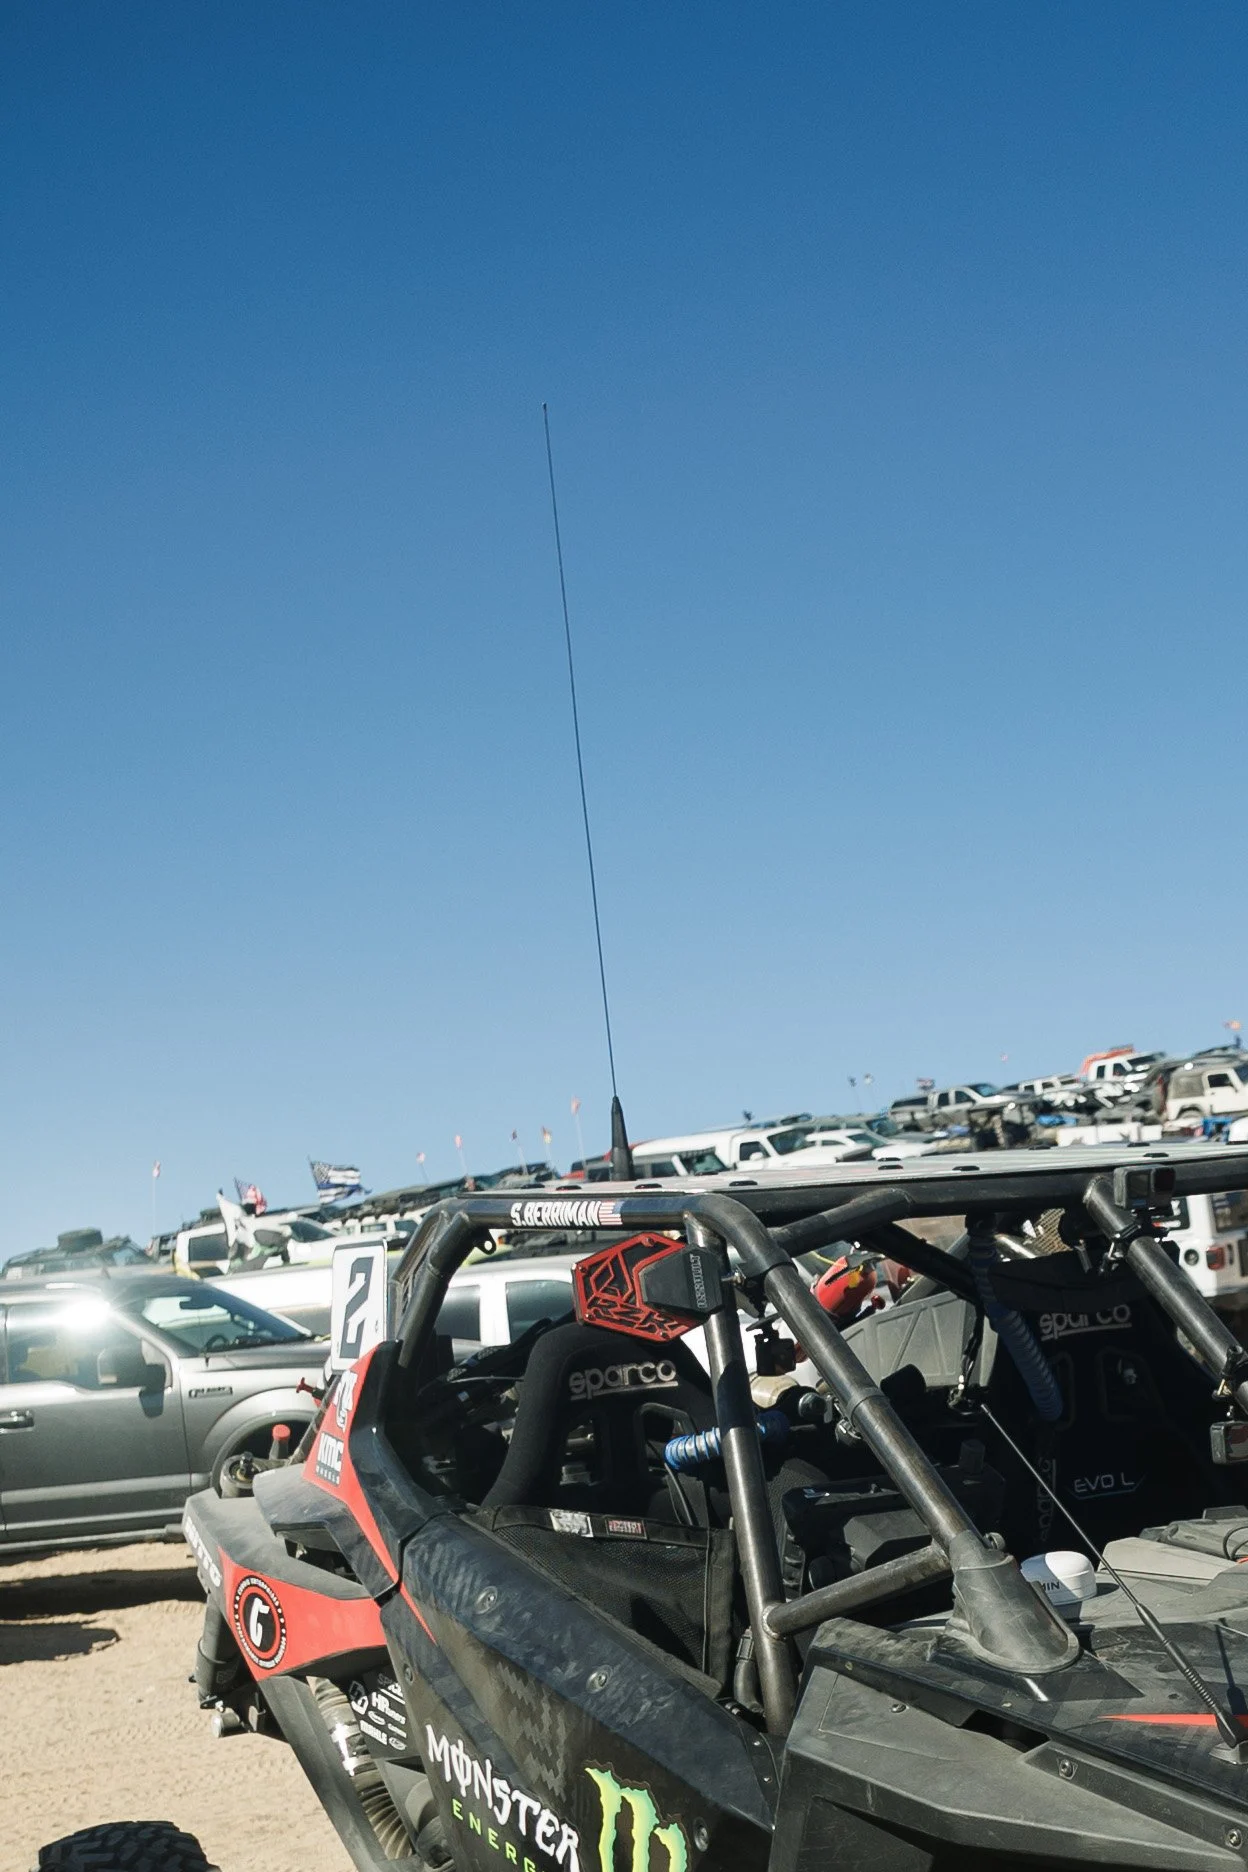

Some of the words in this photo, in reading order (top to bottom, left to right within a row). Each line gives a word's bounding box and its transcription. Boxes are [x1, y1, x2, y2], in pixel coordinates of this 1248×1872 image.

[510, 1201, 602, 1227] S.BERRIMAN
[568, 1359, 678, 1401] sparco
[317, 1431, 345, 1474] KMC
[1074, 1474, 1114, 1493] EVO
[1120, 1471, 1135, 1487] L
